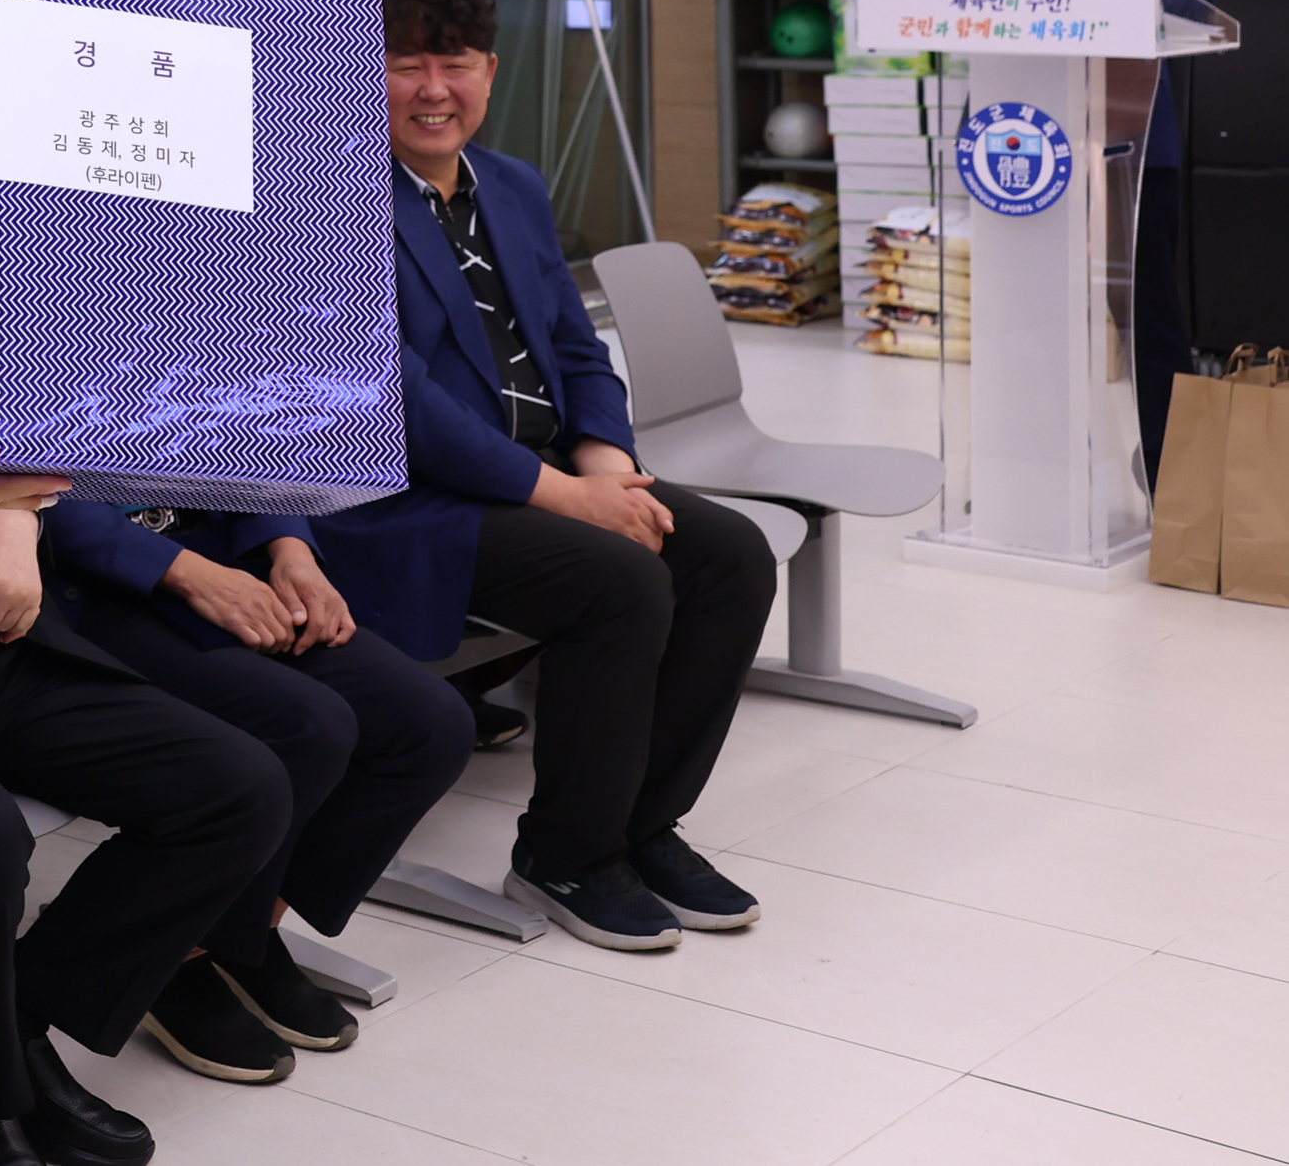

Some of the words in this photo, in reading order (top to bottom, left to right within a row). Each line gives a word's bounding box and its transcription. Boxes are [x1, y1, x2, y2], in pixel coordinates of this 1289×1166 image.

[899, 15, 949, 38] 군민과
[955, 17, 1023, 40] 함께하는
[85, 165, 163, 191] (후라이펜)
